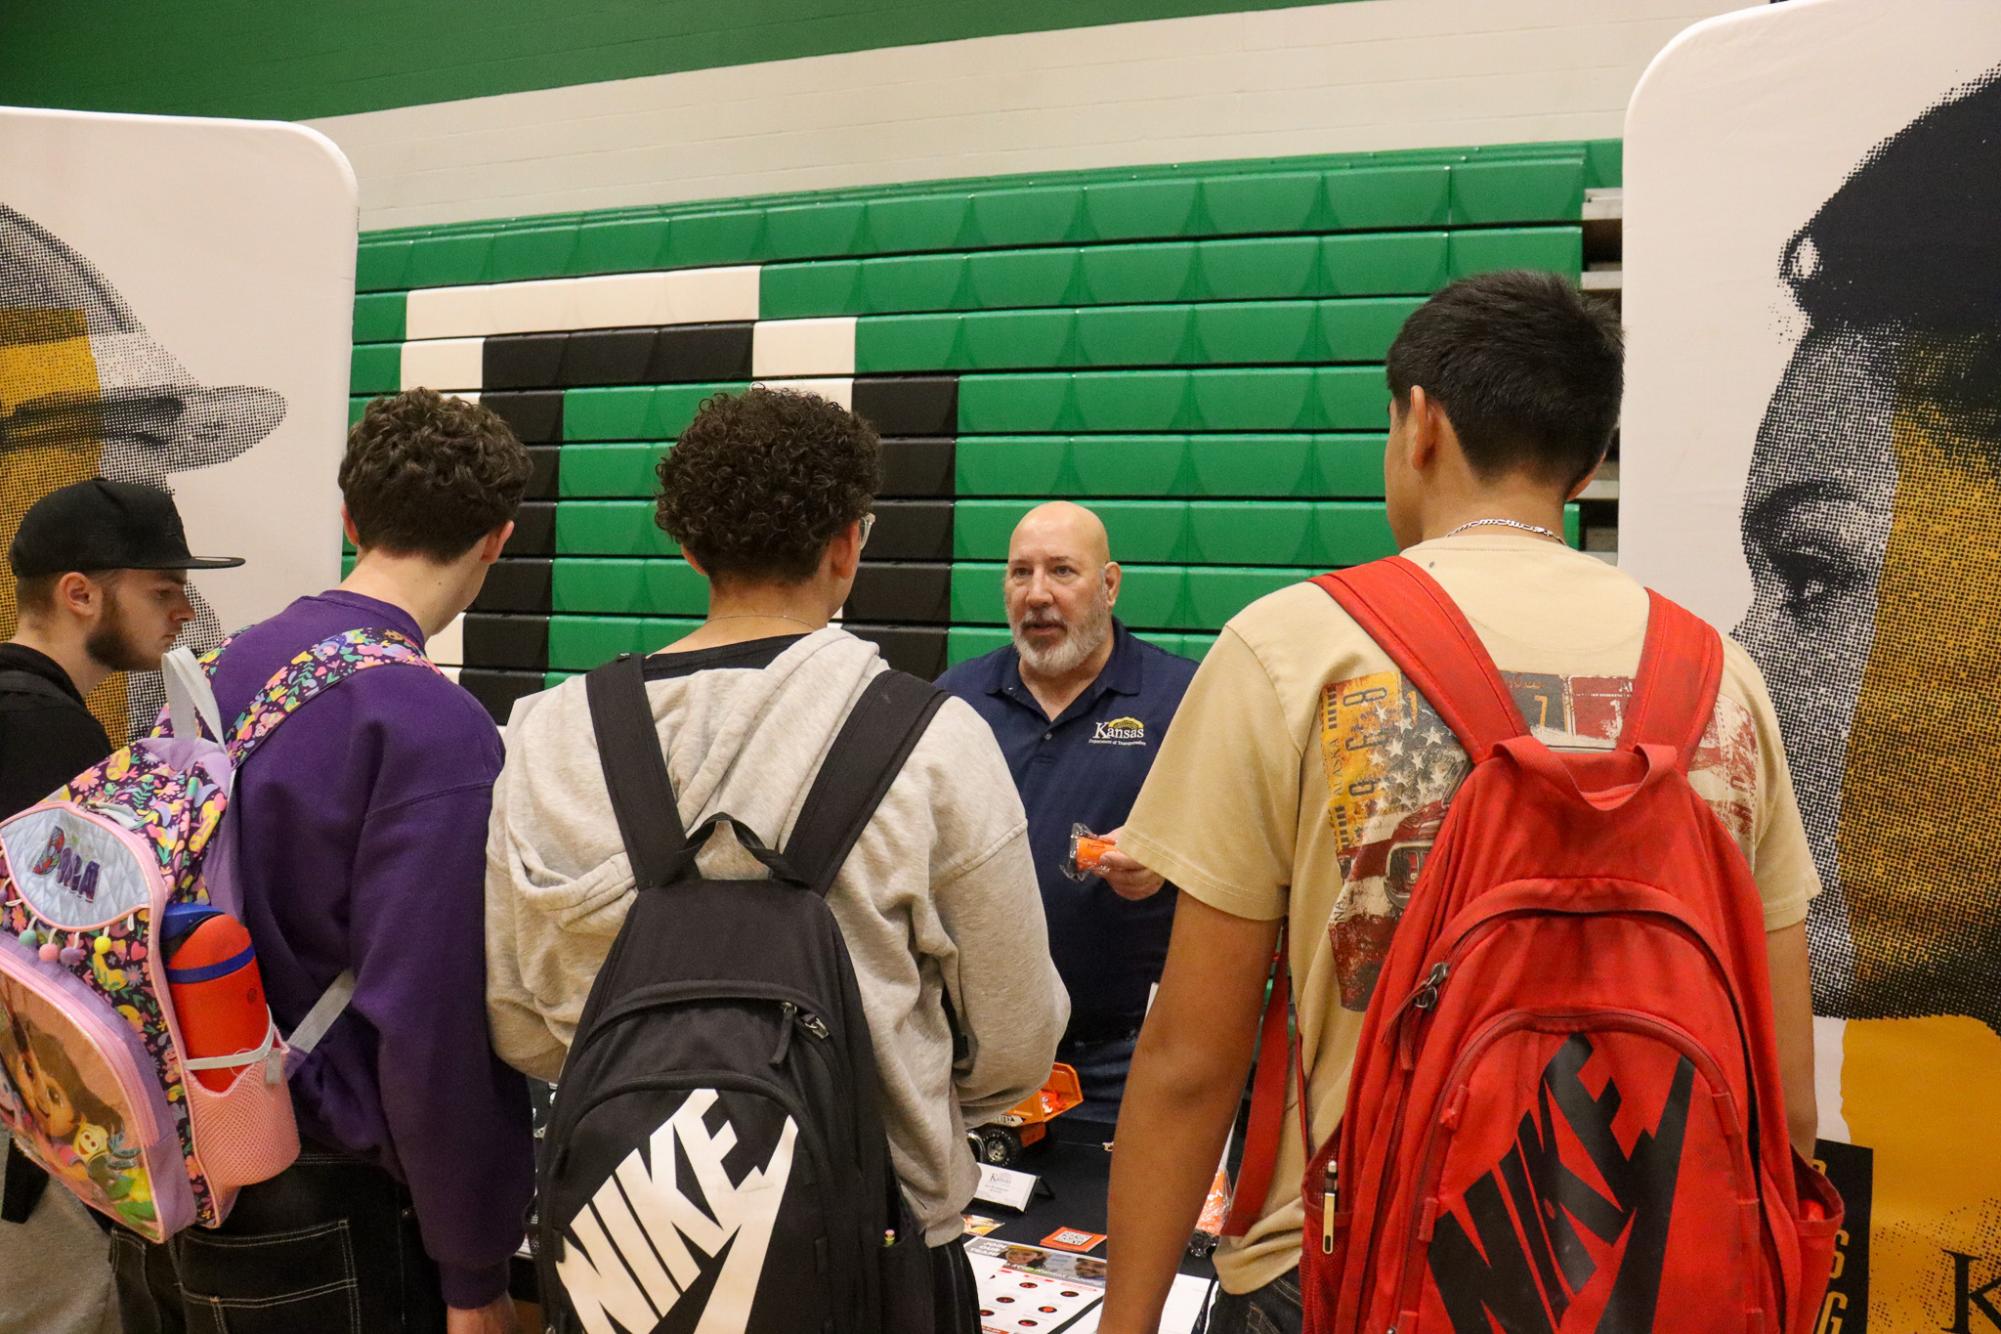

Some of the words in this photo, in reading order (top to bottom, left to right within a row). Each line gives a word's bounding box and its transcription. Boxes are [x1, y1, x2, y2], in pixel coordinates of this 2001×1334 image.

[1092, 721, 1144, 739] Kansas
[555, 1088, 768, 1334] NIKE
[1427, 1031, 1655, 1334] NIKE
[1941, 1249, 2001, 1334] K
